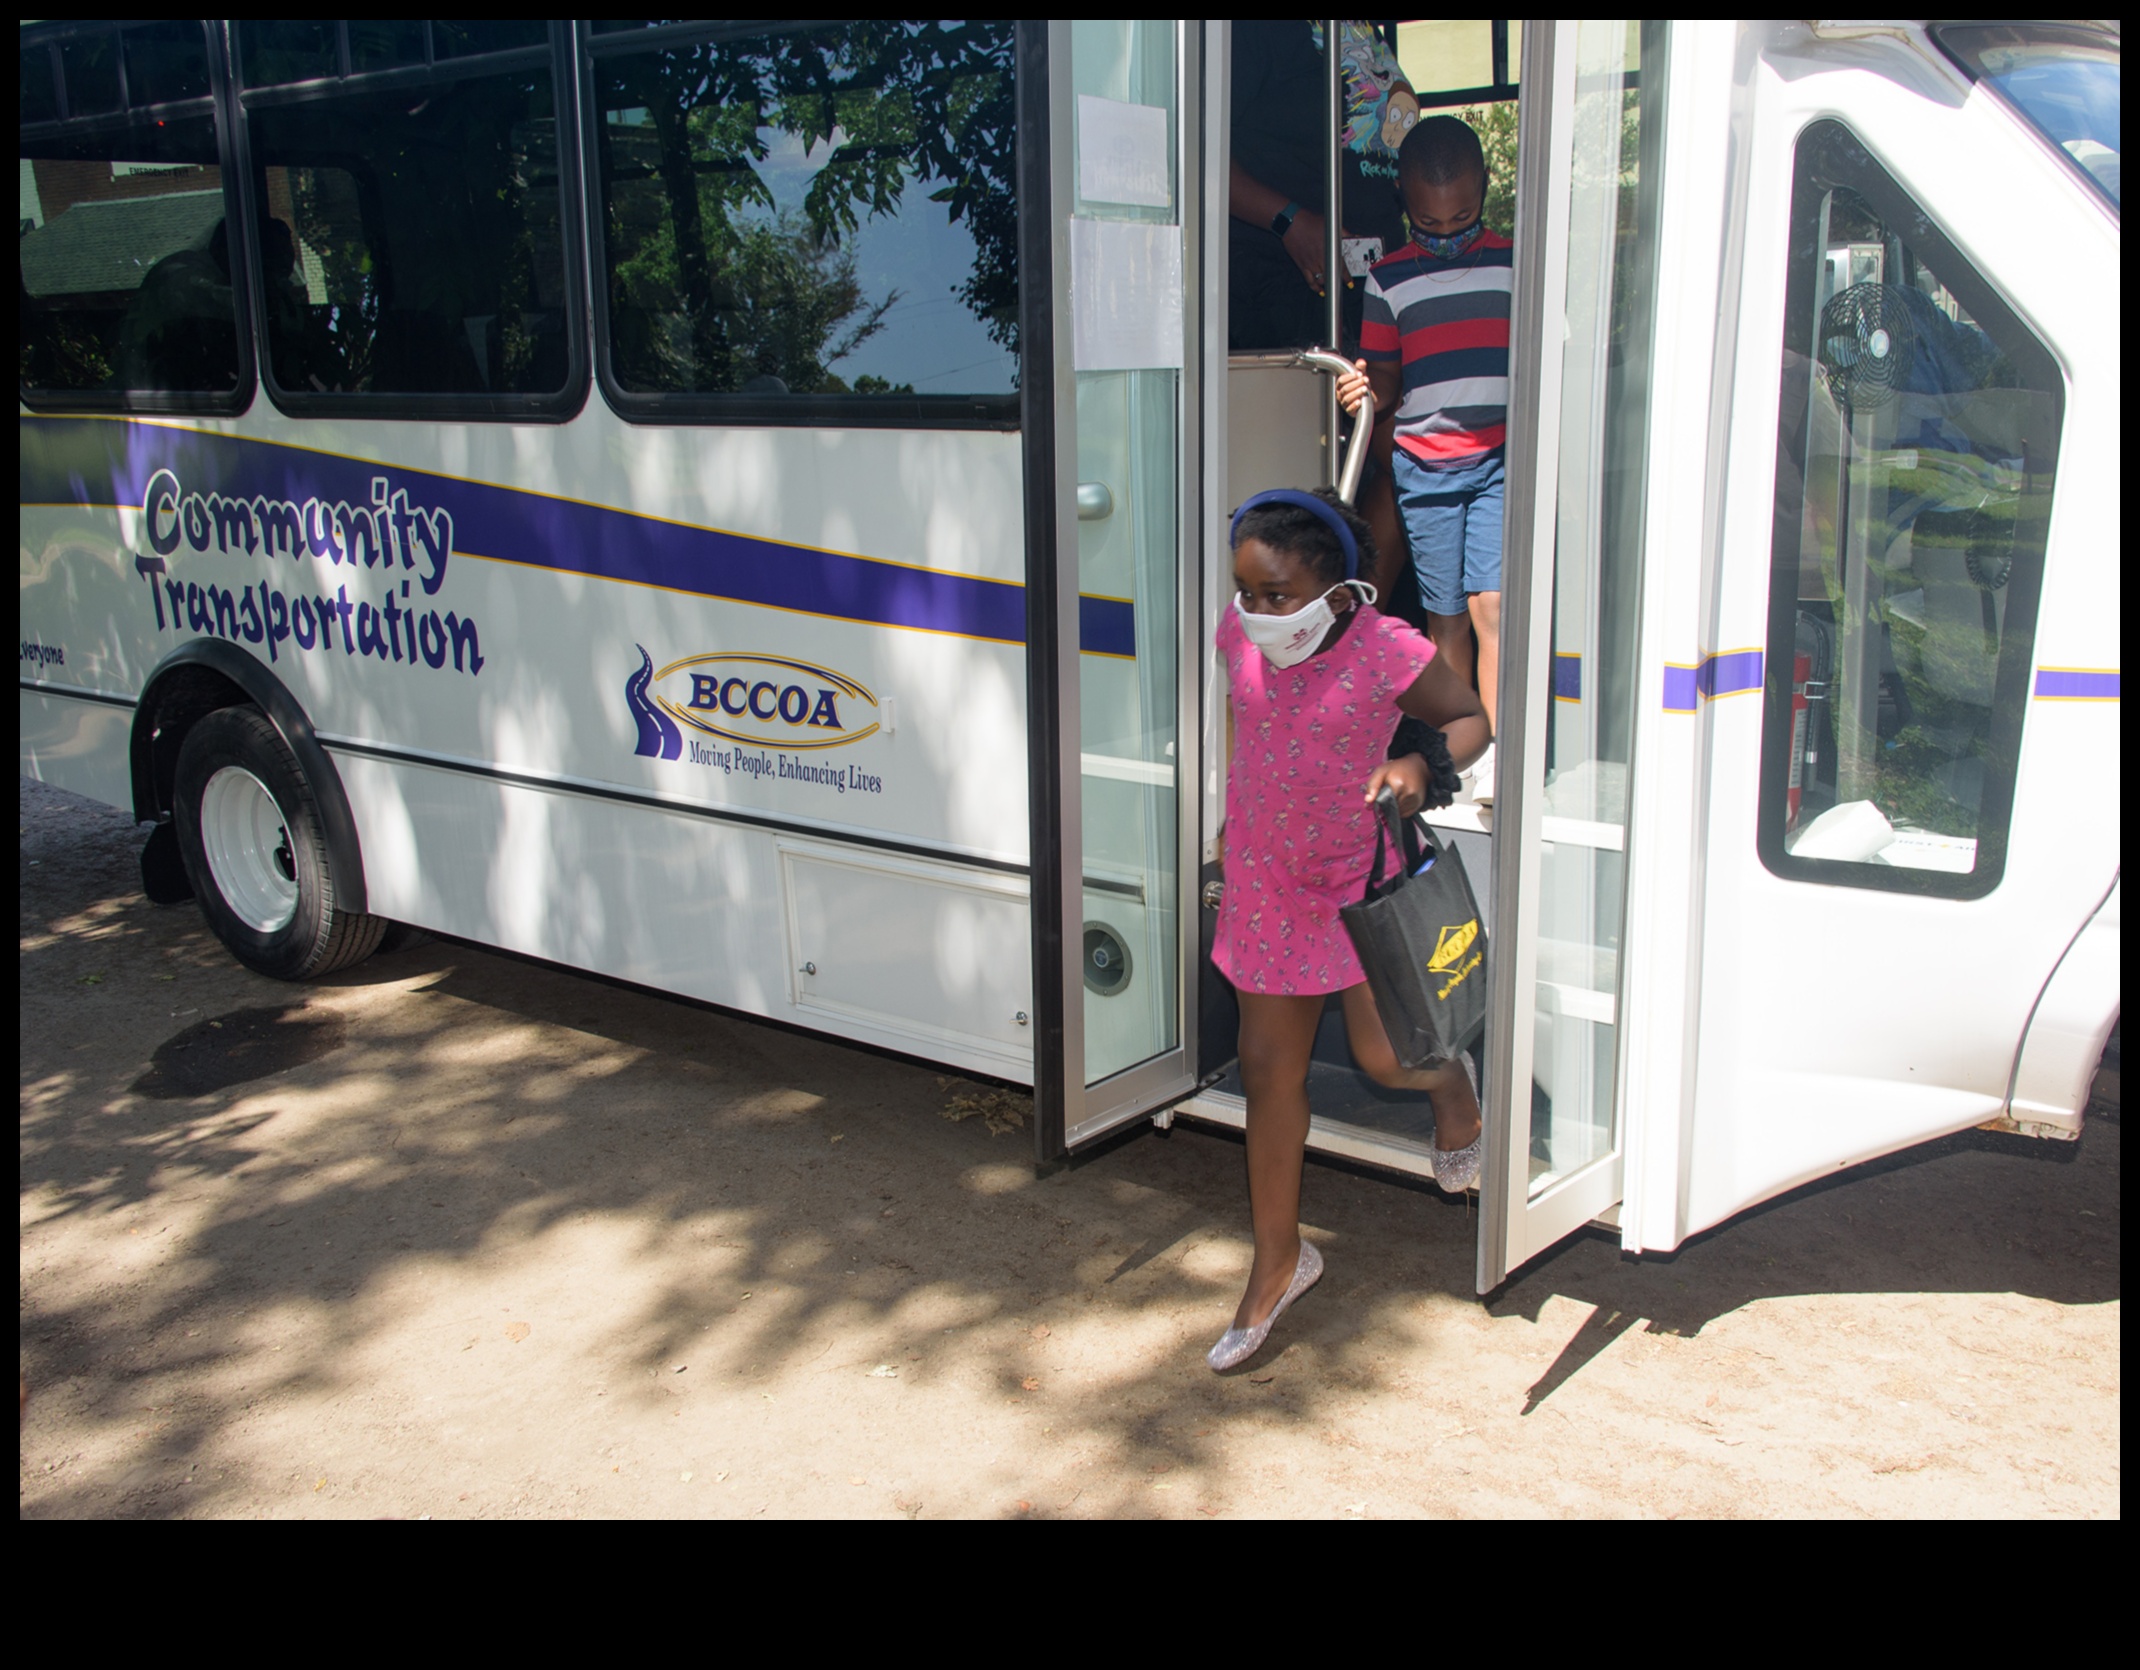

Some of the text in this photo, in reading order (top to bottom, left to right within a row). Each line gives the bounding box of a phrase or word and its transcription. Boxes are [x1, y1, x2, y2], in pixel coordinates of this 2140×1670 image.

[1465, 109, 1484, 123] EXIT
[144, 469, 453, 595] Community
[135, 553, 485, 676] Transportation
[19, 640, 65, 669] veryone
[687, 672, 846, 732] BCCOA
[689, 740, 882, 794] Moving People, Enhancing Lives
